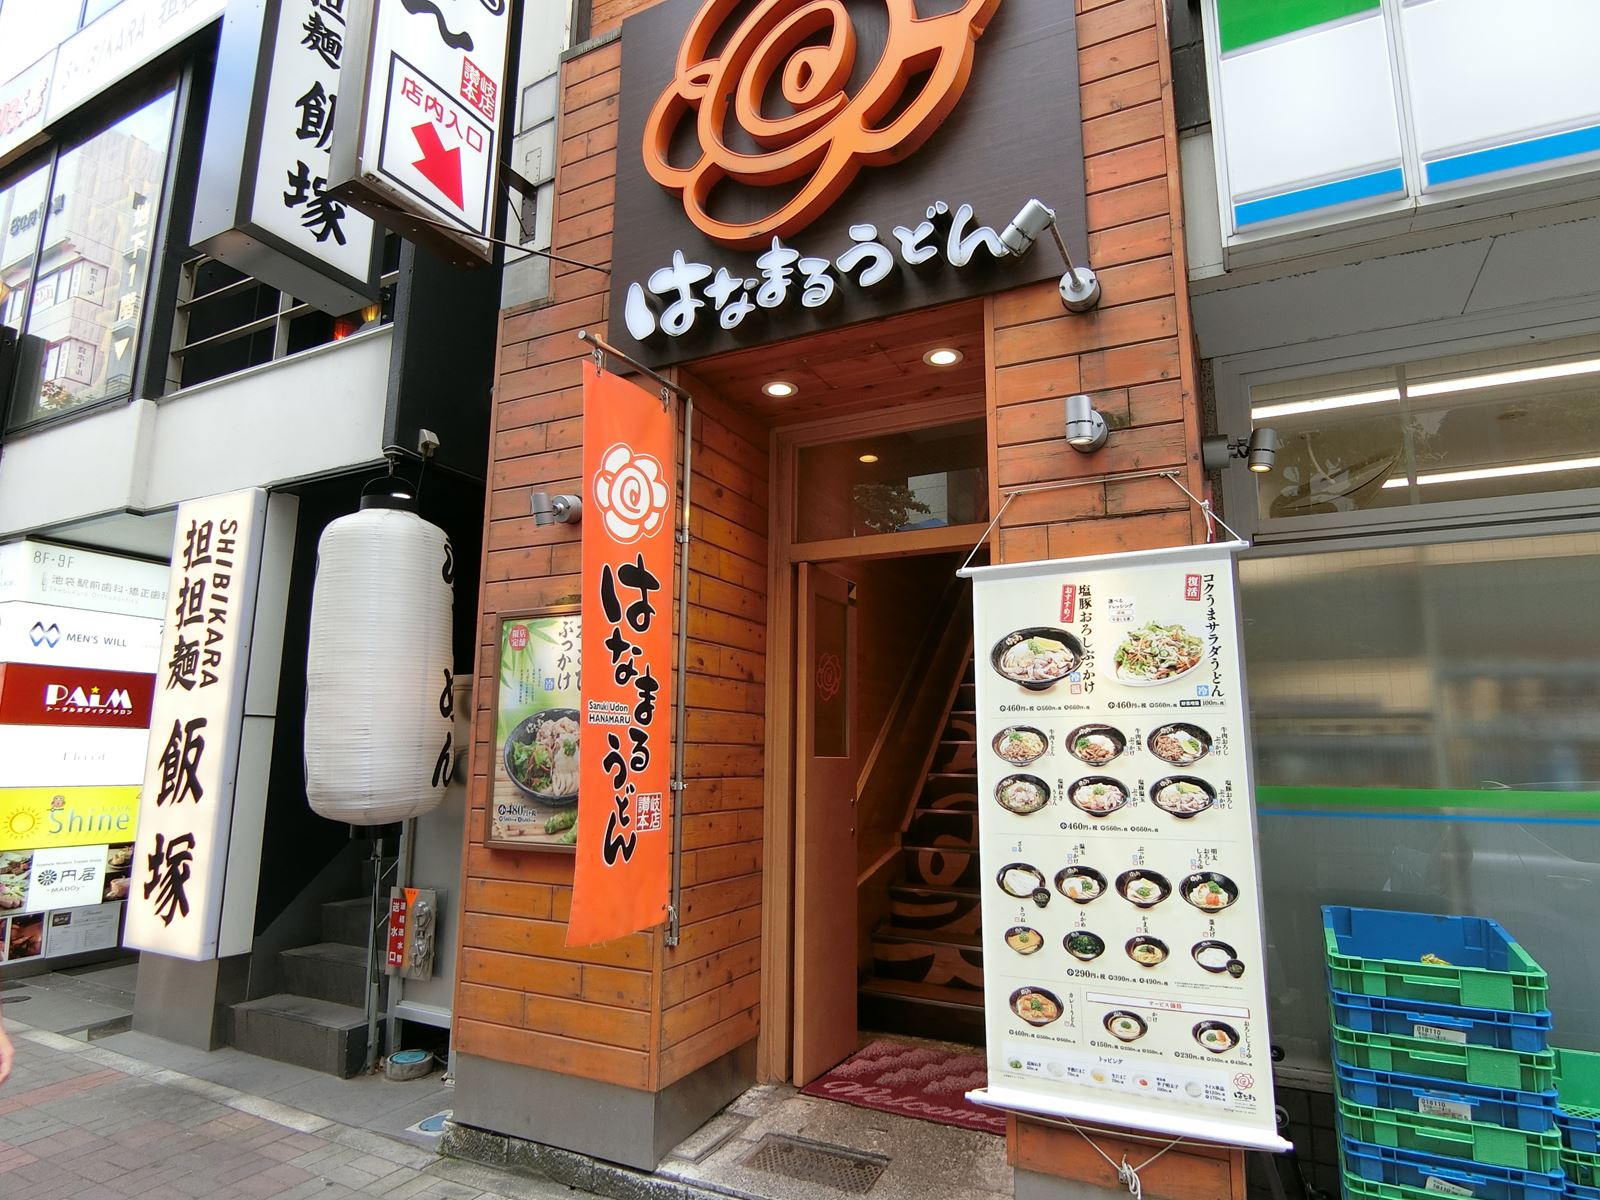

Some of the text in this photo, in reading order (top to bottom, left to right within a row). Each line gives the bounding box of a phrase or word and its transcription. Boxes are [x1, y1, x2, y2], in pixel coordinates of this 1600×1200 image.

[401, 77, 483, 153] 店内入口
[625, 201, 1010, 341] はなまるうどん
[67, 632, 128, 647] MEN'S WILL
[165, 519, 213, 692] 担担麺
[199, 518, 238, 688] SHIBIKARA
[557, 620, 575, 690] ぶっかけ
[1078, 585, 1095, 695] 塩豚おろしぶっかけ
[1203, 573, 1224, 697] コクうまサラダうどん
[589, 714, 631, 724] HANAMARU
[600, 552, 660, 867] はなまるうどん
[610, 702, 628, 711] Udon
[49, 808, 130, 834] Shine
[144, 717, 207, 927] 飯塚
